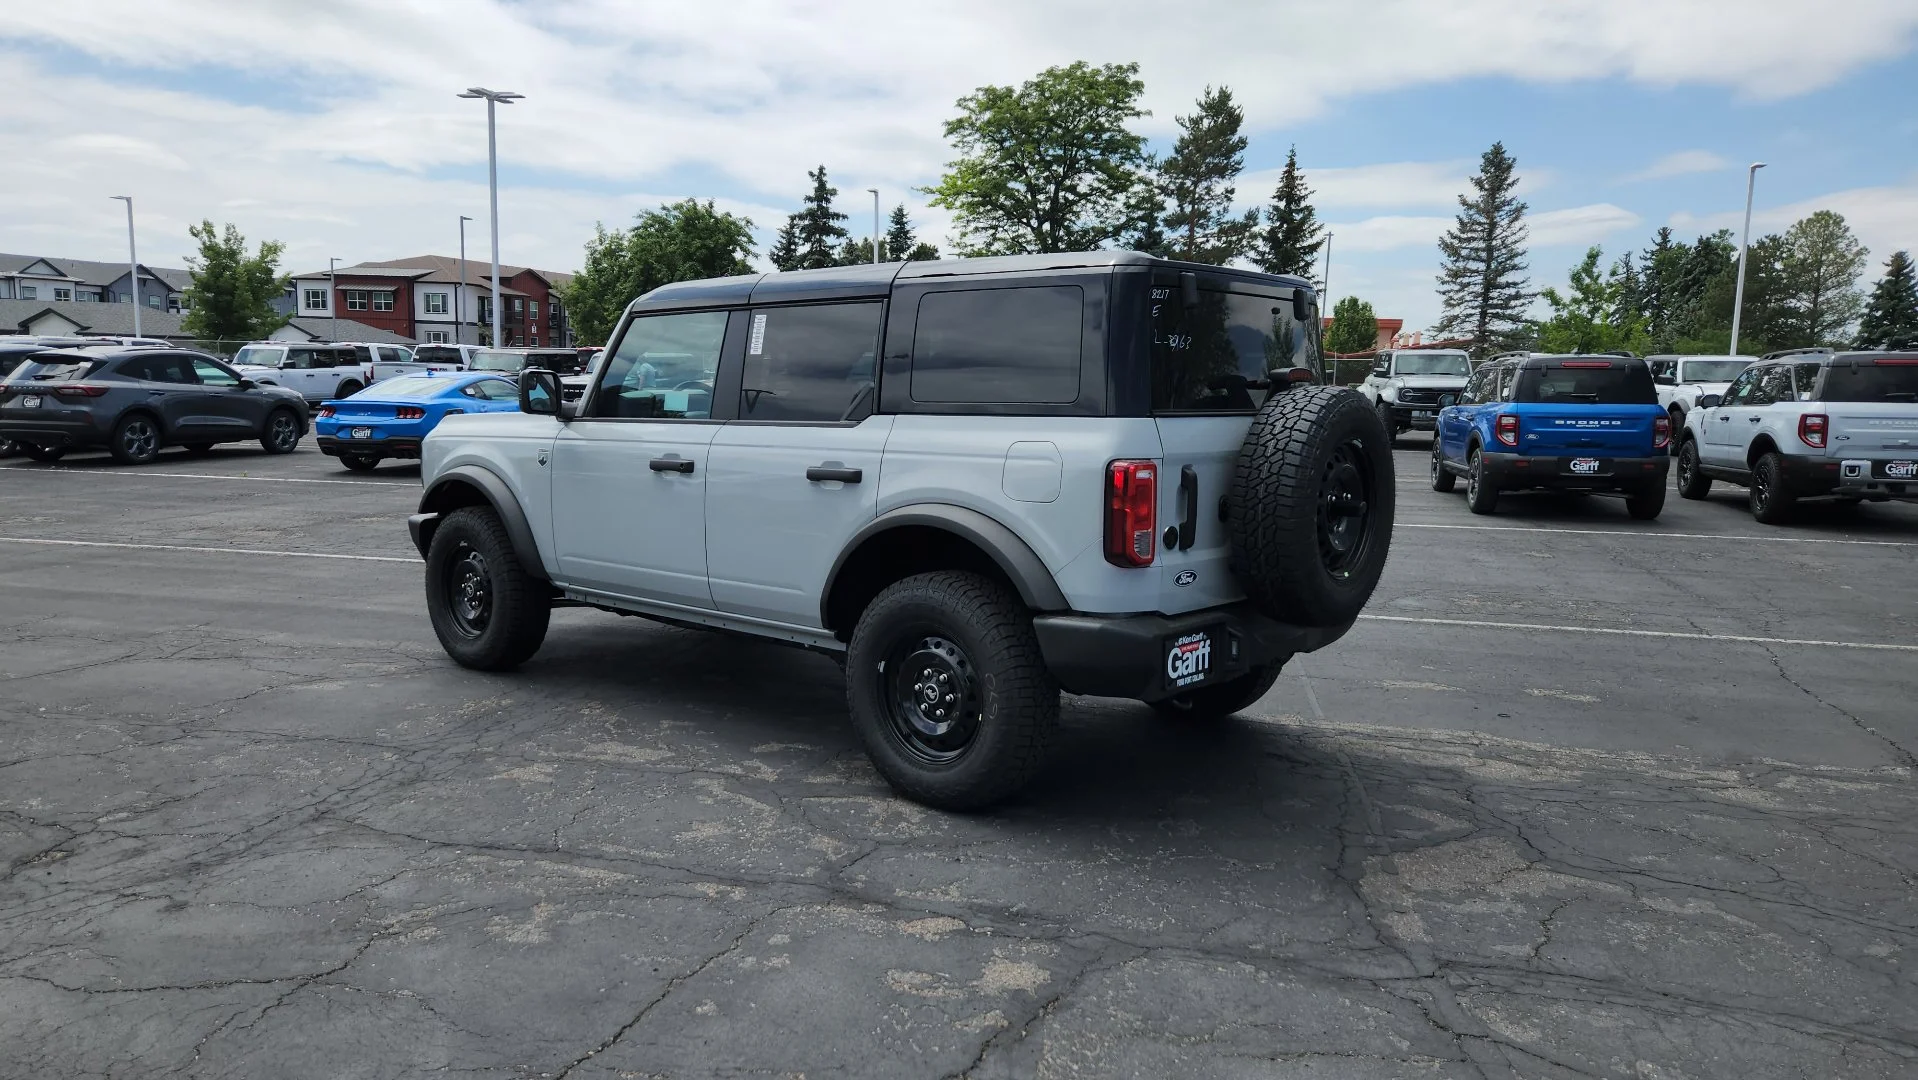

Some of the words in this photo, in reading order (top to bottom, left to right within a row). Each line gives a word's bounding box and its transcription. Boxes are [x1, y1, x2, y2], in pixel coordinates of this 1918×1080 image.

[1151, 288, 1170, 300] 8217
[1151, 304, 1162, 317] E
[352, 428, 372, 437] Garff
[1570, 460, 1600, 471] Garff
[1885, 463, 1918, 475] Garff
[1177, 572, 1195, 585] Ford
[1167, 639, 1211, 679] Garff
